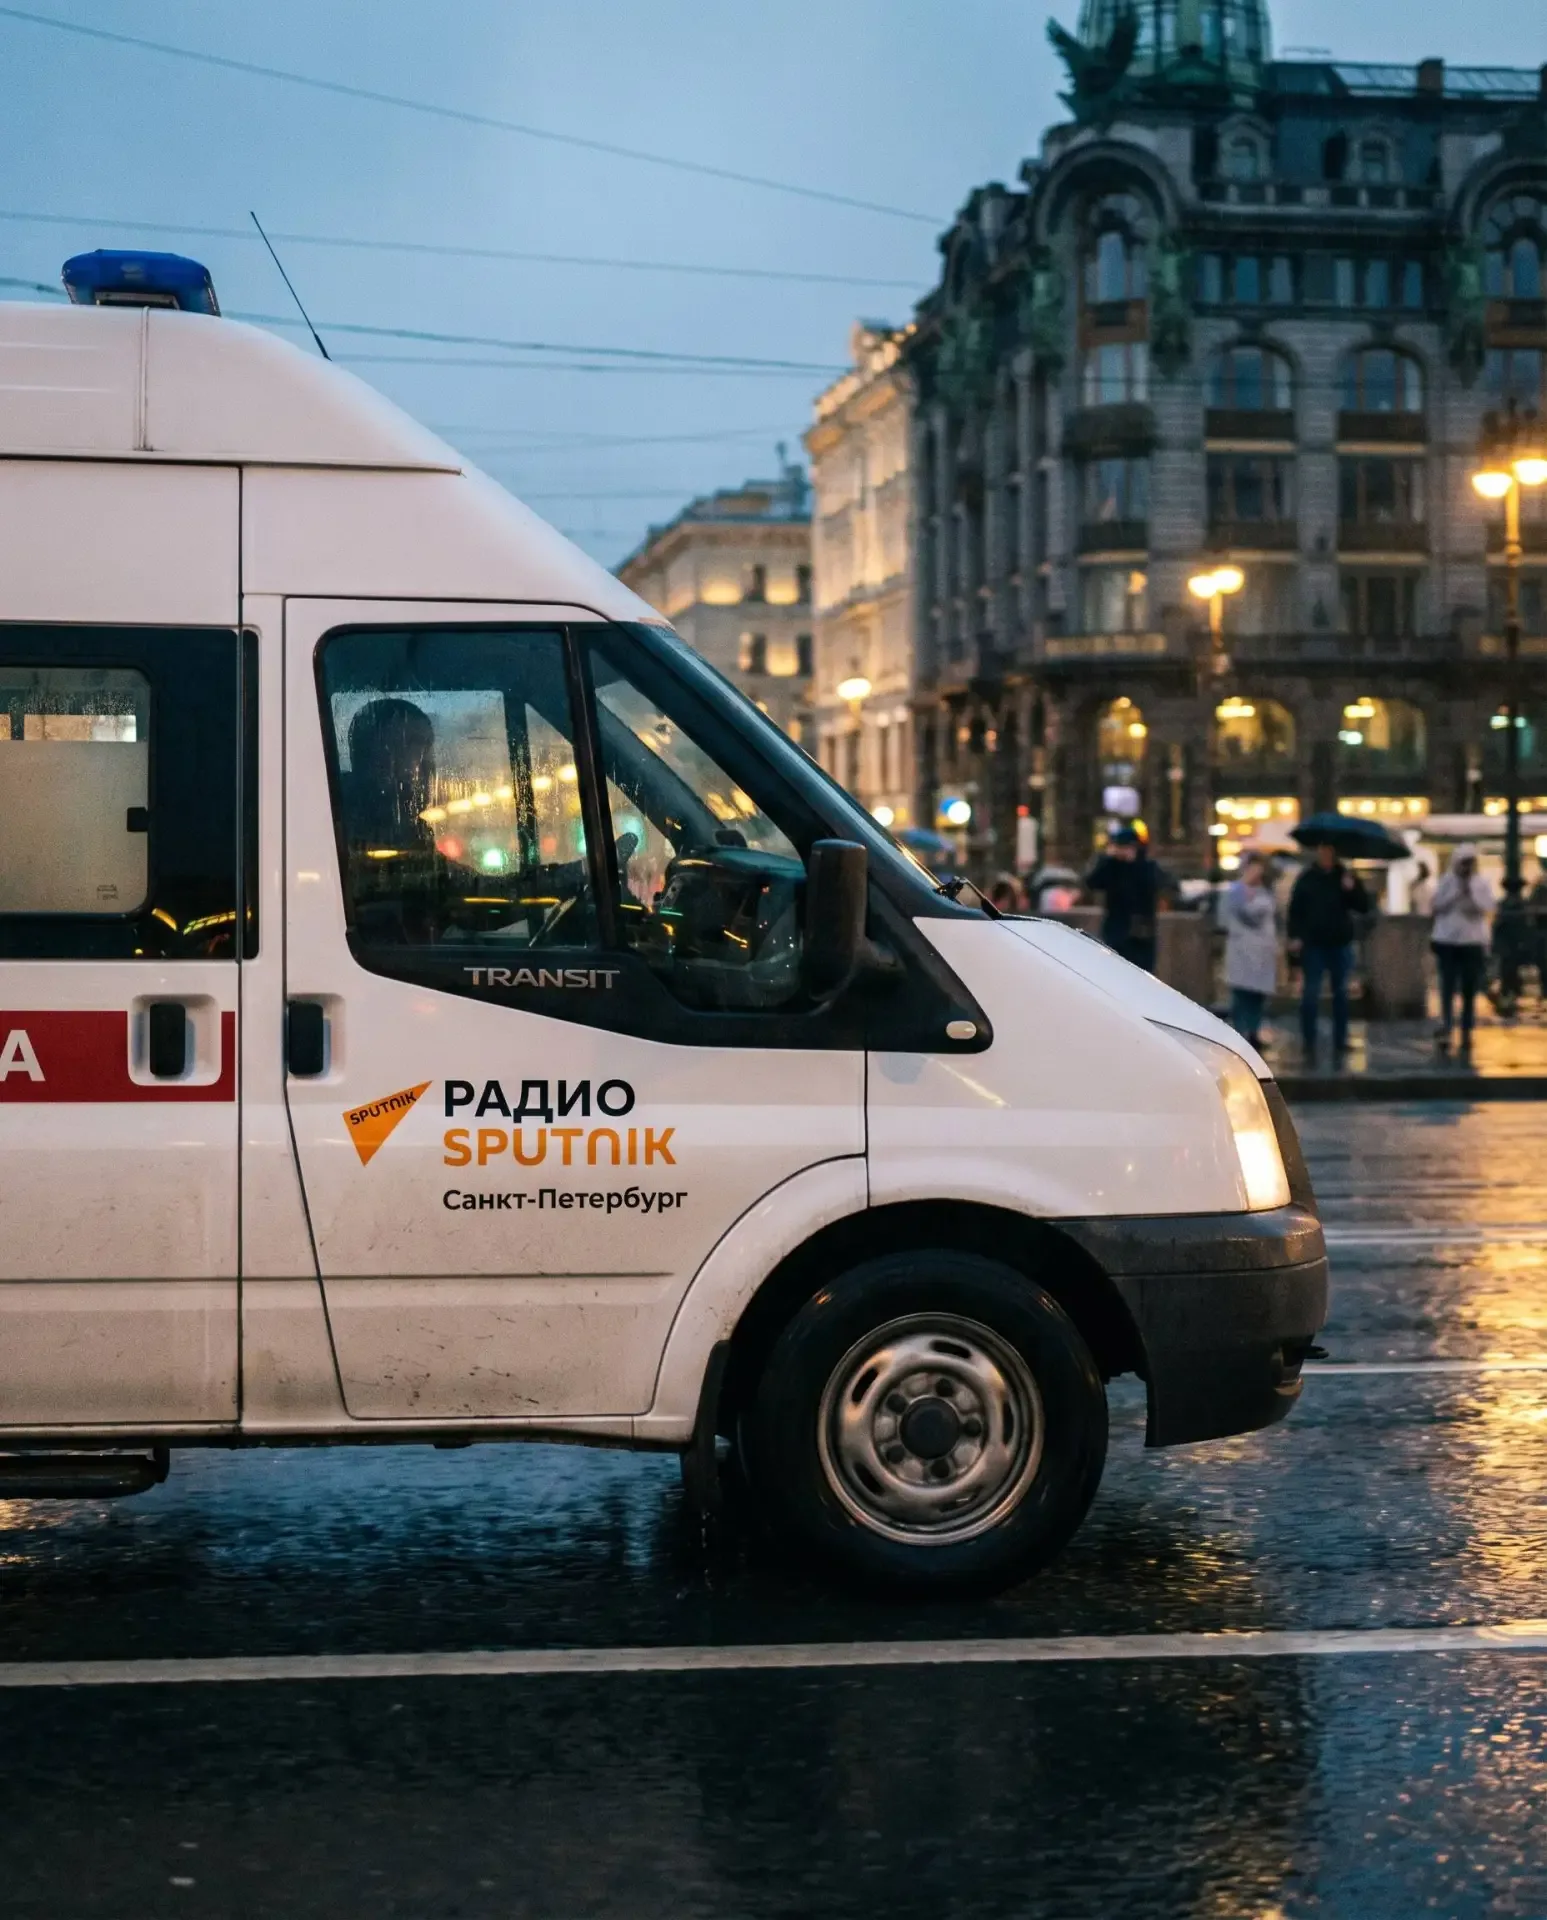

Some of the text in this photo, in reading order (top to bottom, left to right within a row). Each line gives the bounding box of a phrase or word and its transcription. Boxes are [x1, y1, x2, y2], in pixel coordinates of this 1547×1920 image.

[463, 966, 621, 989] TRANSIT
[349, 1091, 417, 1126] SPUTNIK
[444, 1079, 635, 1124] РАДИО
[443, 1127, 677, 1167] SPUTNIK
[442, 1186, 688, 1213] Санкт-Петербург
